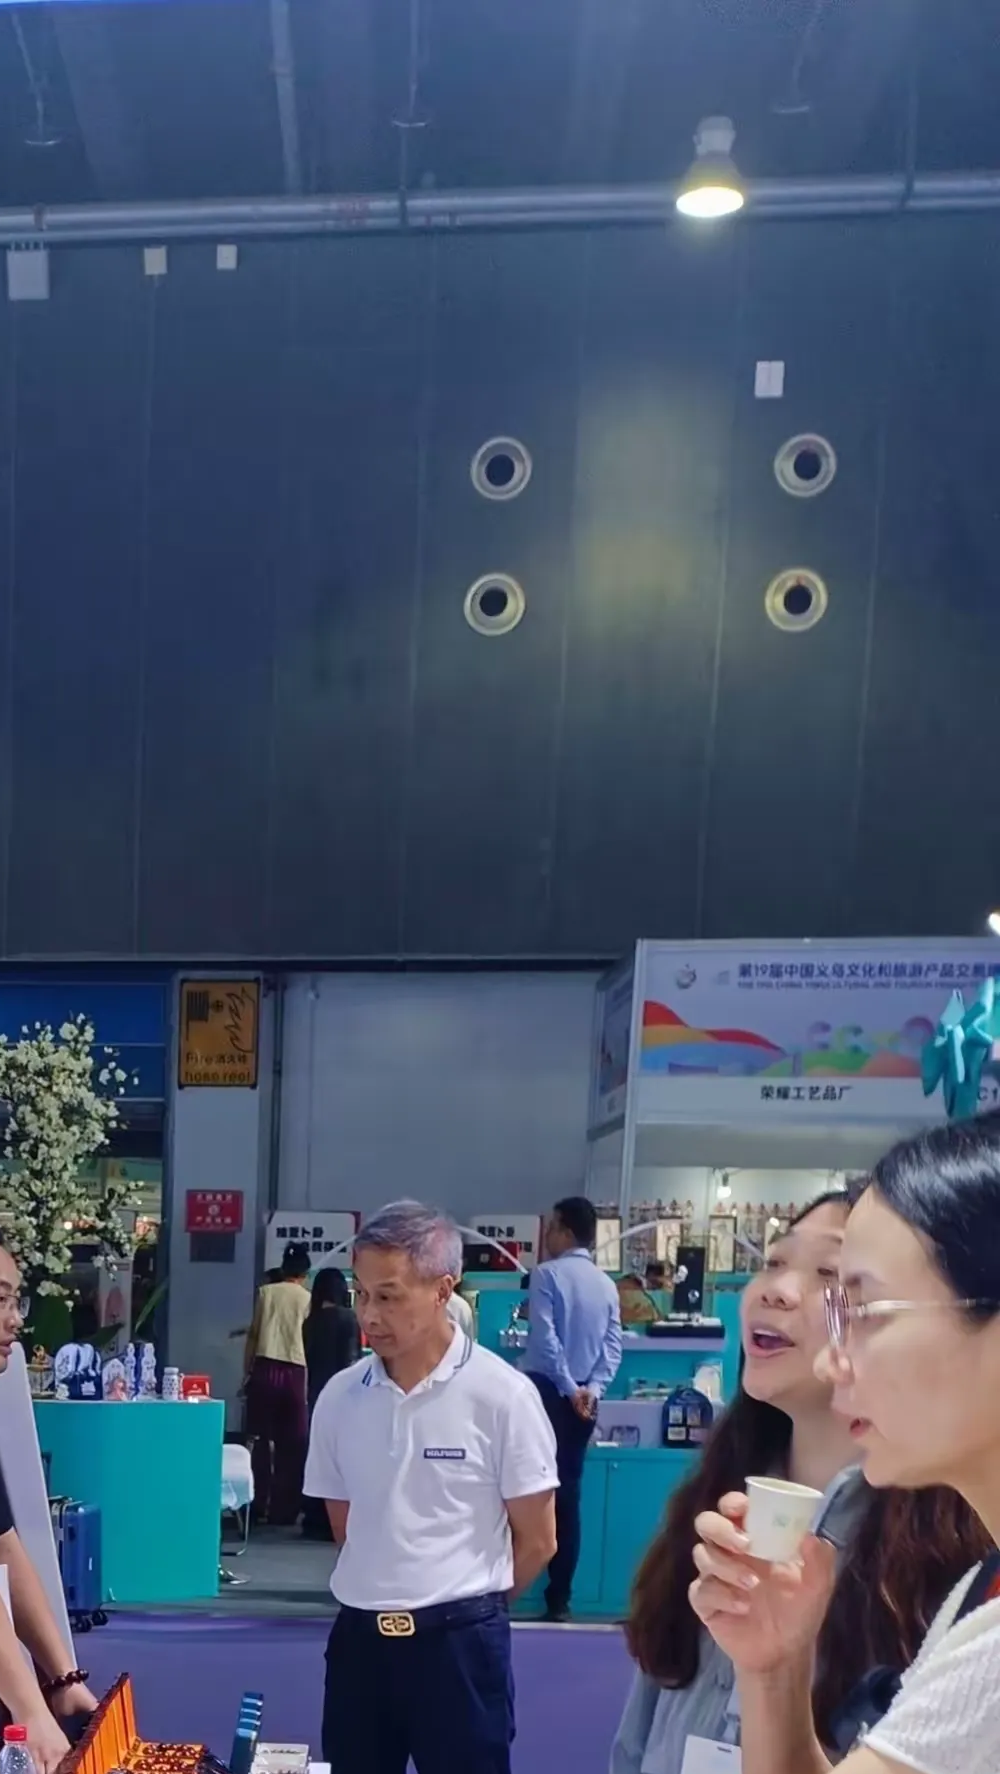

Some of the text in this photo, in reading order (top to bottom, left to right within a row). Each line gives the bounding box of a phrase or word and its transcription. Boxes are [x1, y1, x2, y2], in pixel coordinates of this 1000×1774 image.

[760, 1085, 852, 1101] 荣耀工艺品厂
